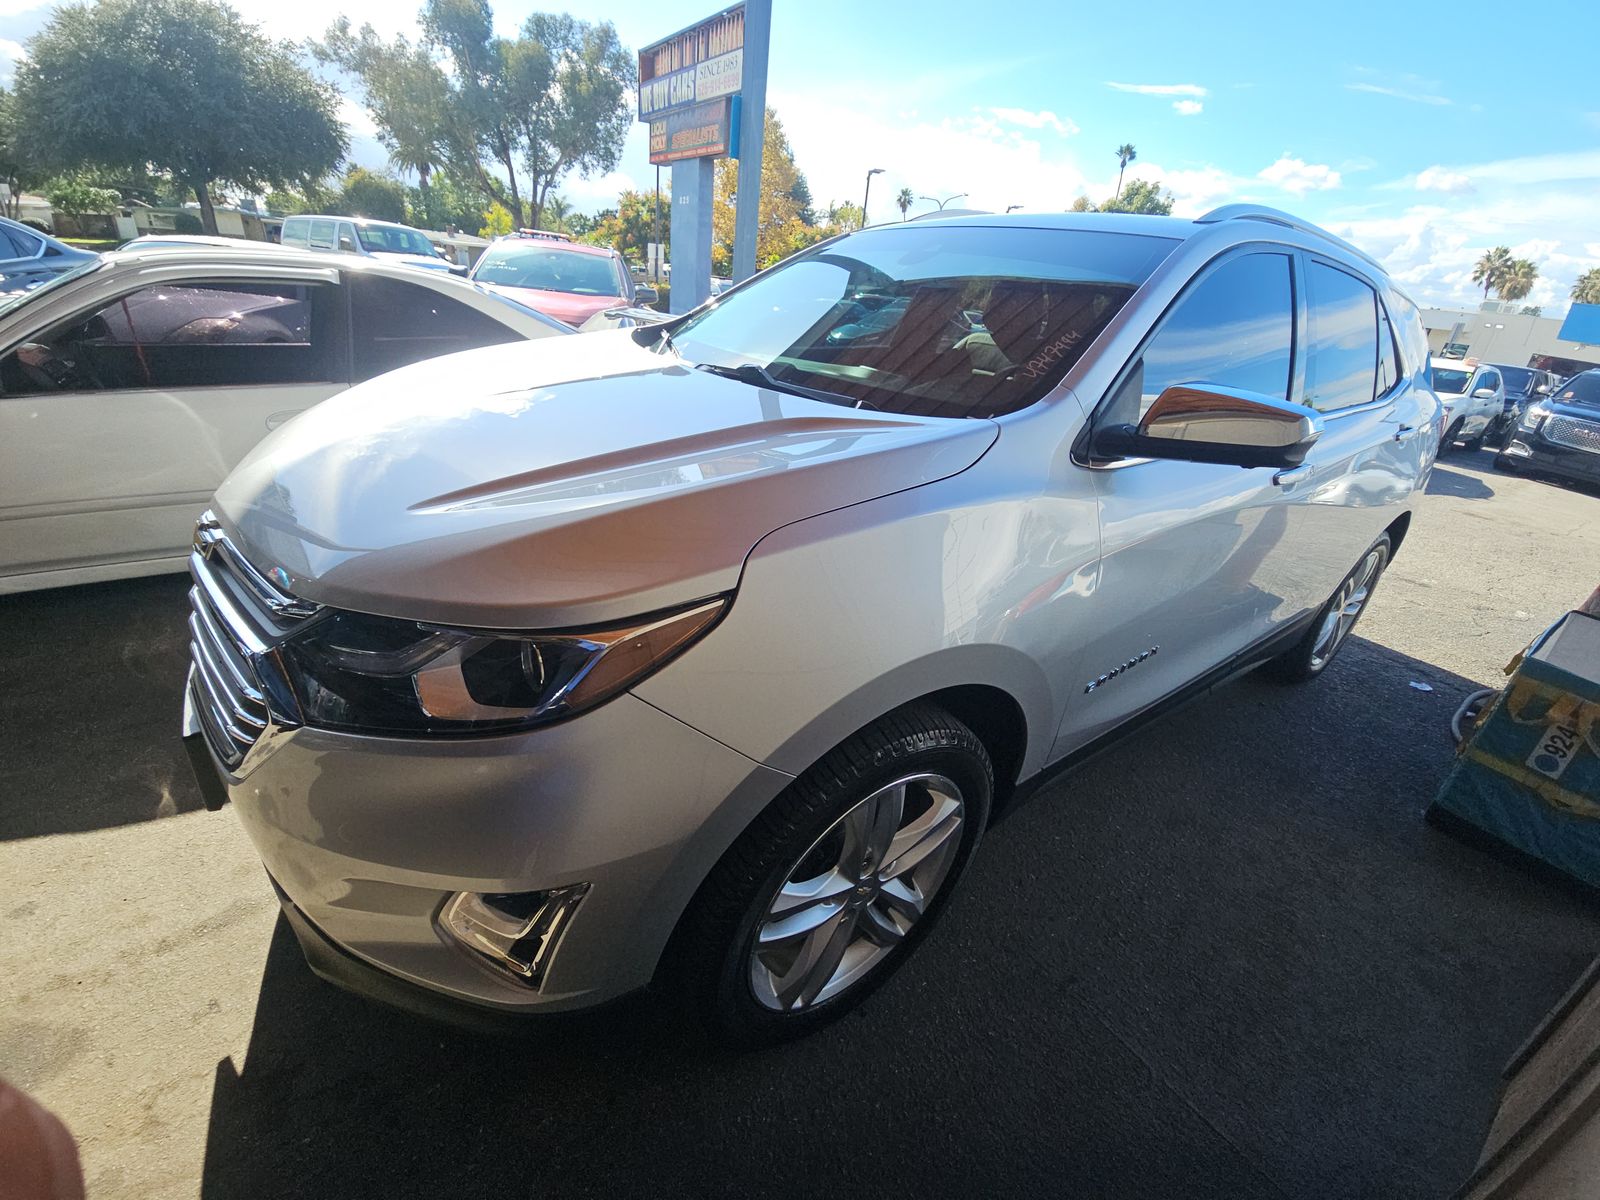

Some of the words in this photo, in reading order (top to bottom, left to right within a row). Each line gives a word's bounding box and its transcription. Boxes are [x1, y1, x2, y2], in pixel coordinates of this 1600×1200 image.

[699, 60, 721, 80] SINCE
[641, 84, 653, 114] WE
[653, 77, 669, 111] BUY
[670, 69, 696, 105] CARS
[1543, 724, 1579, 759] 924
